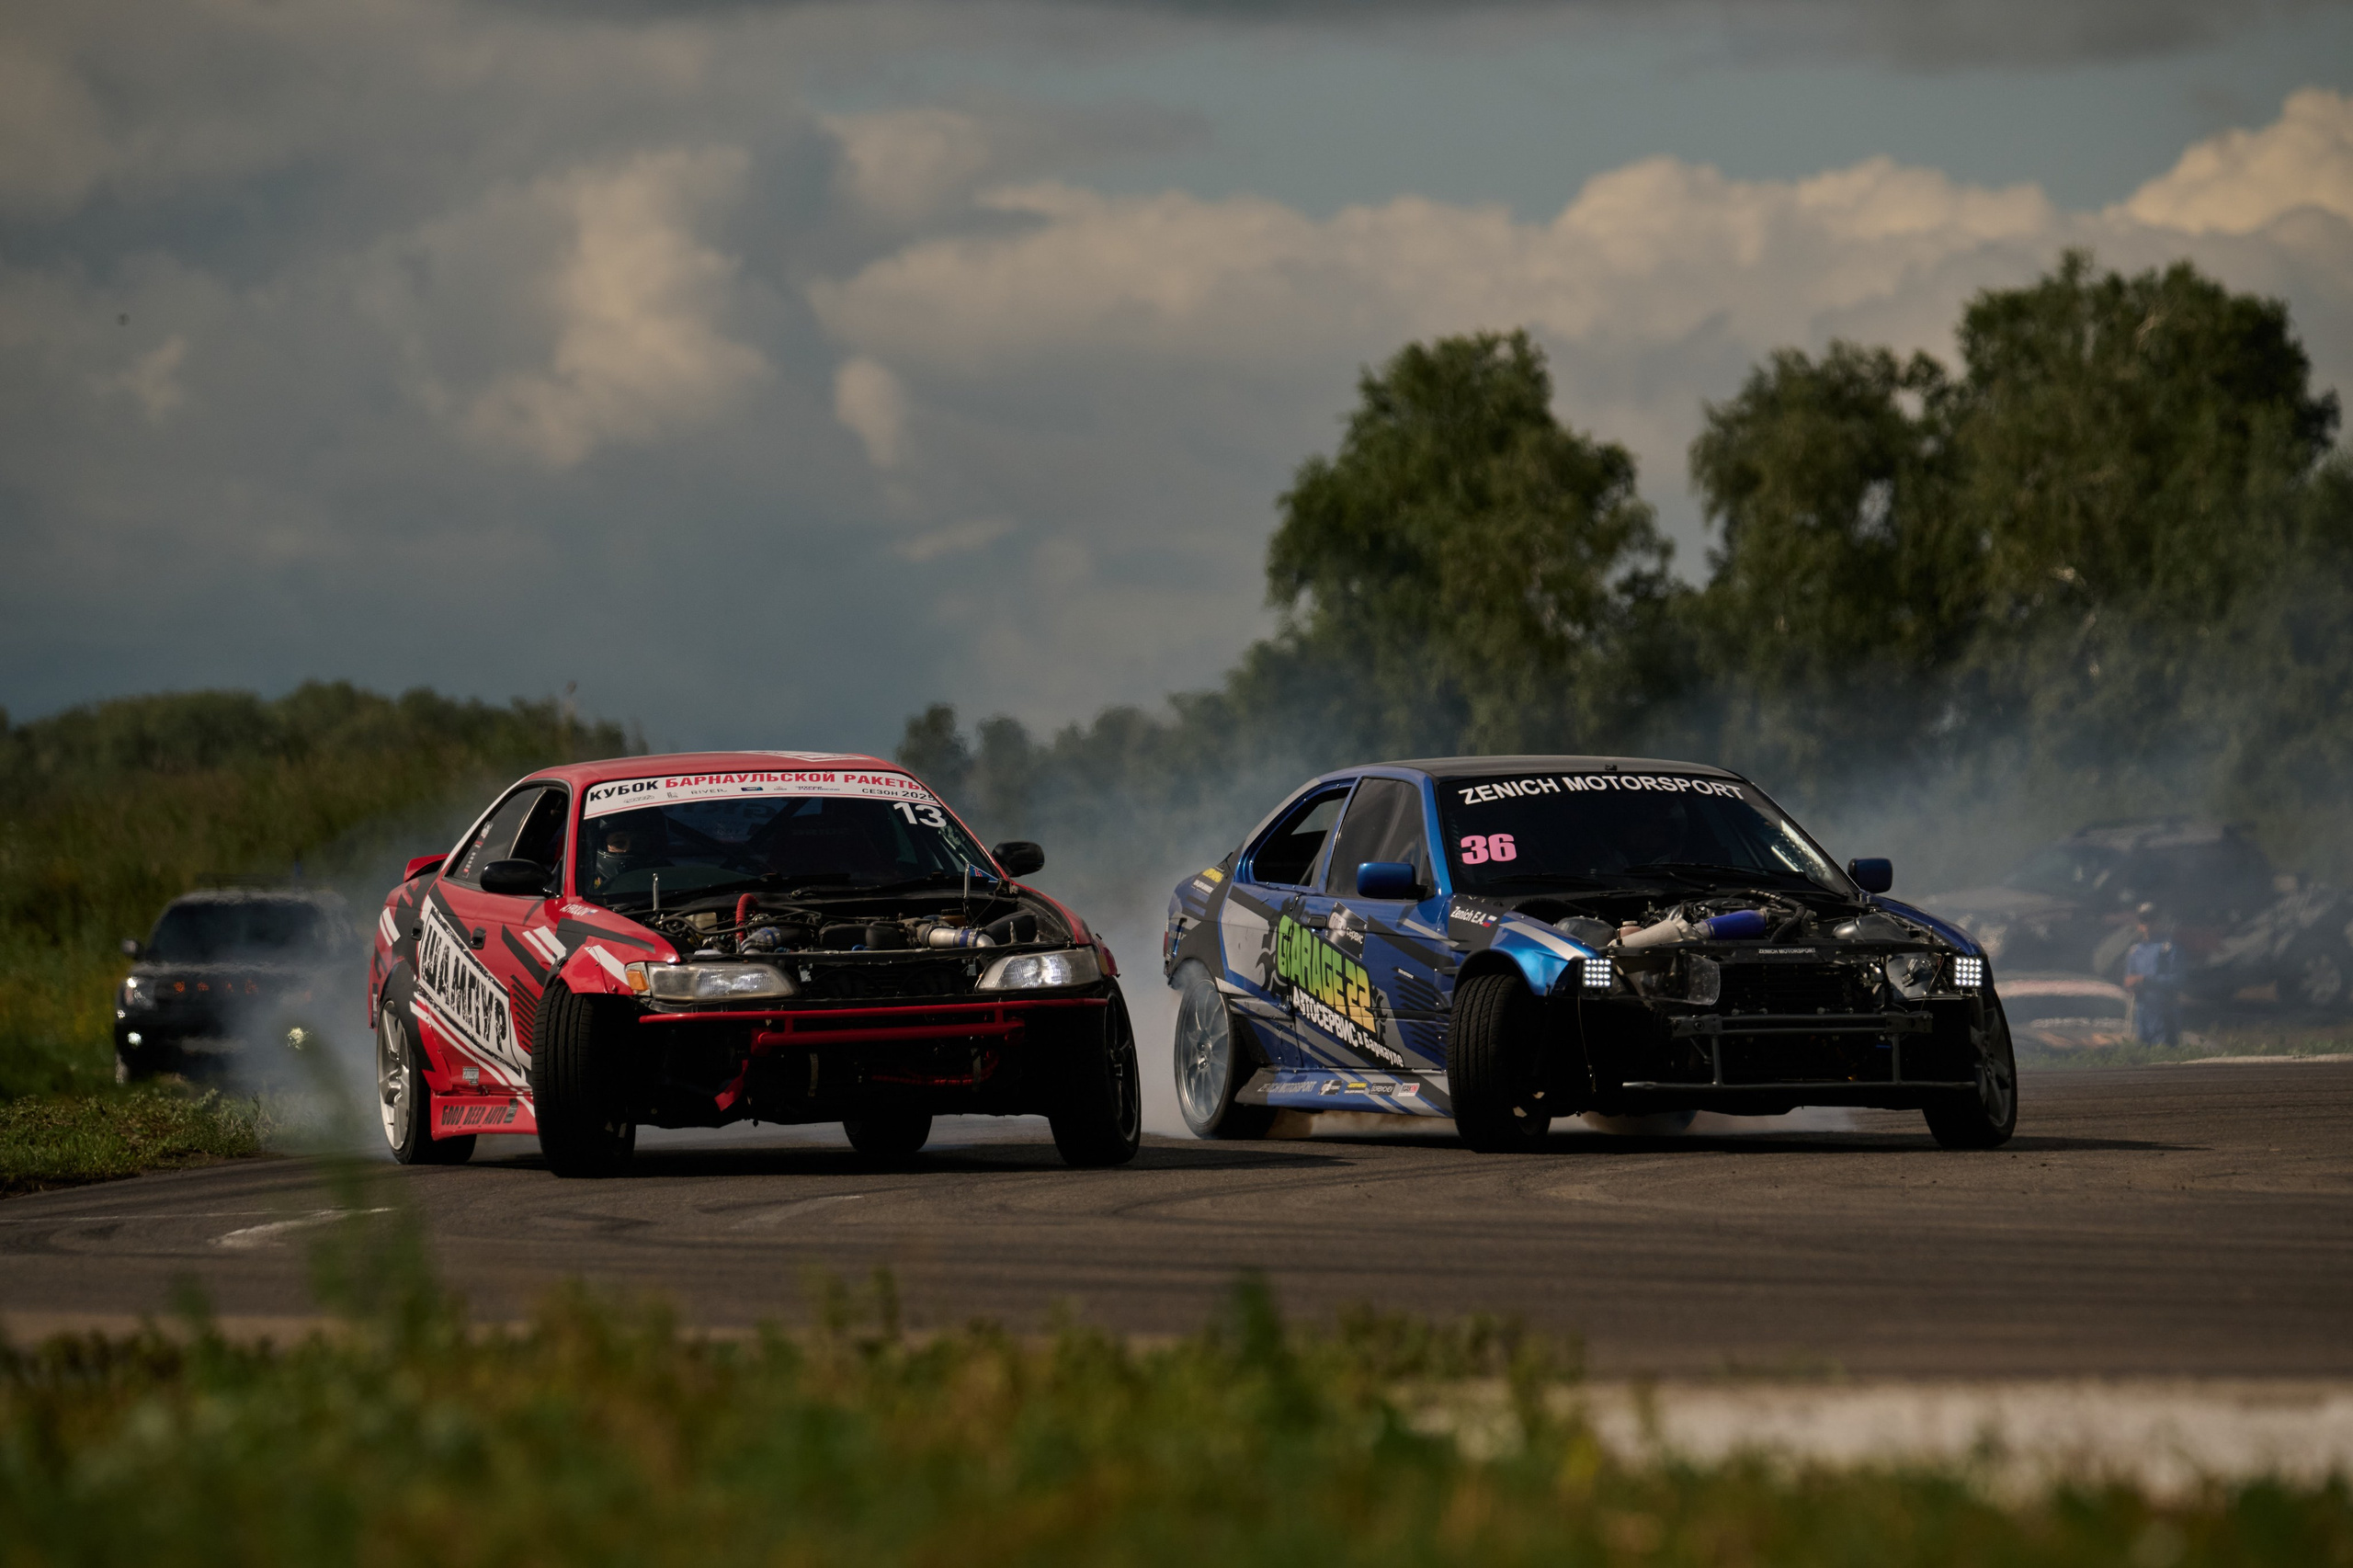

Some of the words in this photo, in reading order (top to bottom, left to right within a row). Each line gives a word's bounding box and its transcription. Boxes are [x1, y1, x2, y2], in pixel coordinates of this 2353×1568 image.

[589, 779, 659, 802] КУБОК
[665, 771, 835, 789] БАРНАУЛЬСКОЙ
[861, 788, 899, 797] СЕЗОН
[902, 790, 937, 801] 2025
[1458, 778, 1562, 805] ZENICH
[1561, 775, 1745, 801] MOTORSPORT
[892, 801, 948, 828] 13
[1460, 833, 1518, 865] 36
[1449, 905, 1474, 922] Zenich
